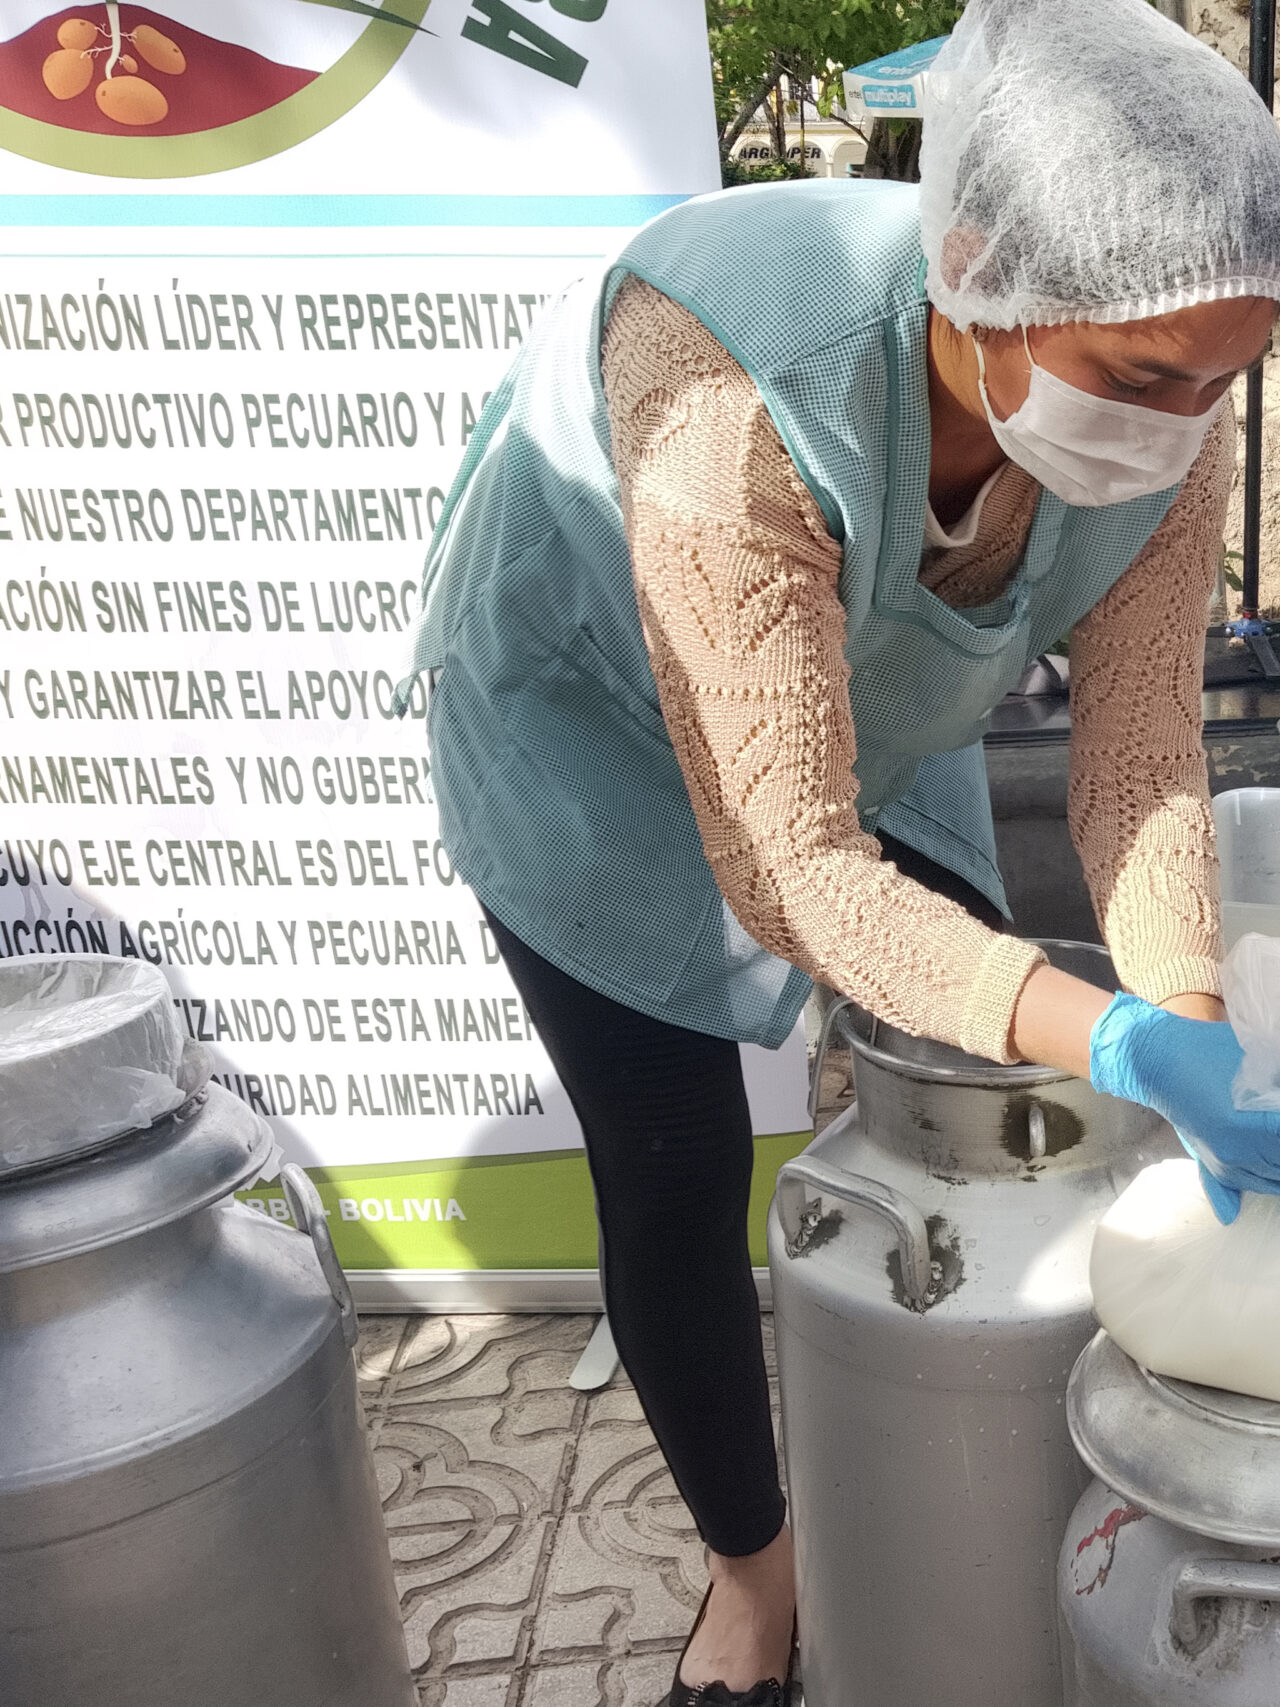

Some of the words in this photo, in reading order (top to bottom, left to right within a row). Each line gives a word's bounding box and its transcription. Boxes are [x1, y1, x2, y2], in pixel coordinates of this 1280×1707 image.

[739, 147, 821, 159] ARGPER
[154, 278, 261, 351] LÍDER
[262, 295, 285, 350] Y
[296, 293, 567, 350] REPRESENTAT
[13, 393, 234, 448] PRODUCTIVO
[241, 392, 417, 448] PECUARIO
[424, 392, 444, 446] Y
[16, 489, 173, 542] NUESTRO
[92, 581, 148, 633] SIN
[153, 581, 251, 632] FINES
[258, 582, 304, 632] DE
[25, 669, 232, 719] GARANTIZAR
[236, 671, 281, 719] EL
[0, 756, 214, 805] NAMENTALES
[226, 757, 247, 804] Y
[257, 756, 303, 804] NO
[79, 841, 139, 886] EJE
[147, 840, 291, 886] CENTRAL
[296, 840, 337, 886] ES
[345, 841, 407, 885] DEL
[413, 839, 467, 885] FO
[119, 907, 275, 965] AGRÍCOLA
[278, 921, 298, 964] Y
[307, 920, 466, 965] PECUARIA
[173, 999, 295, 1042] IZANDO
[303, 1000, 345, 1041] DE
[351, 998, 430, 1042] ESTA
[210, 1074, 336, 1116] RIDAD
[348, 1074, 545, 1116] ALIMENTARIA
[338, 1198, 467, 1222] BOLIVIA
